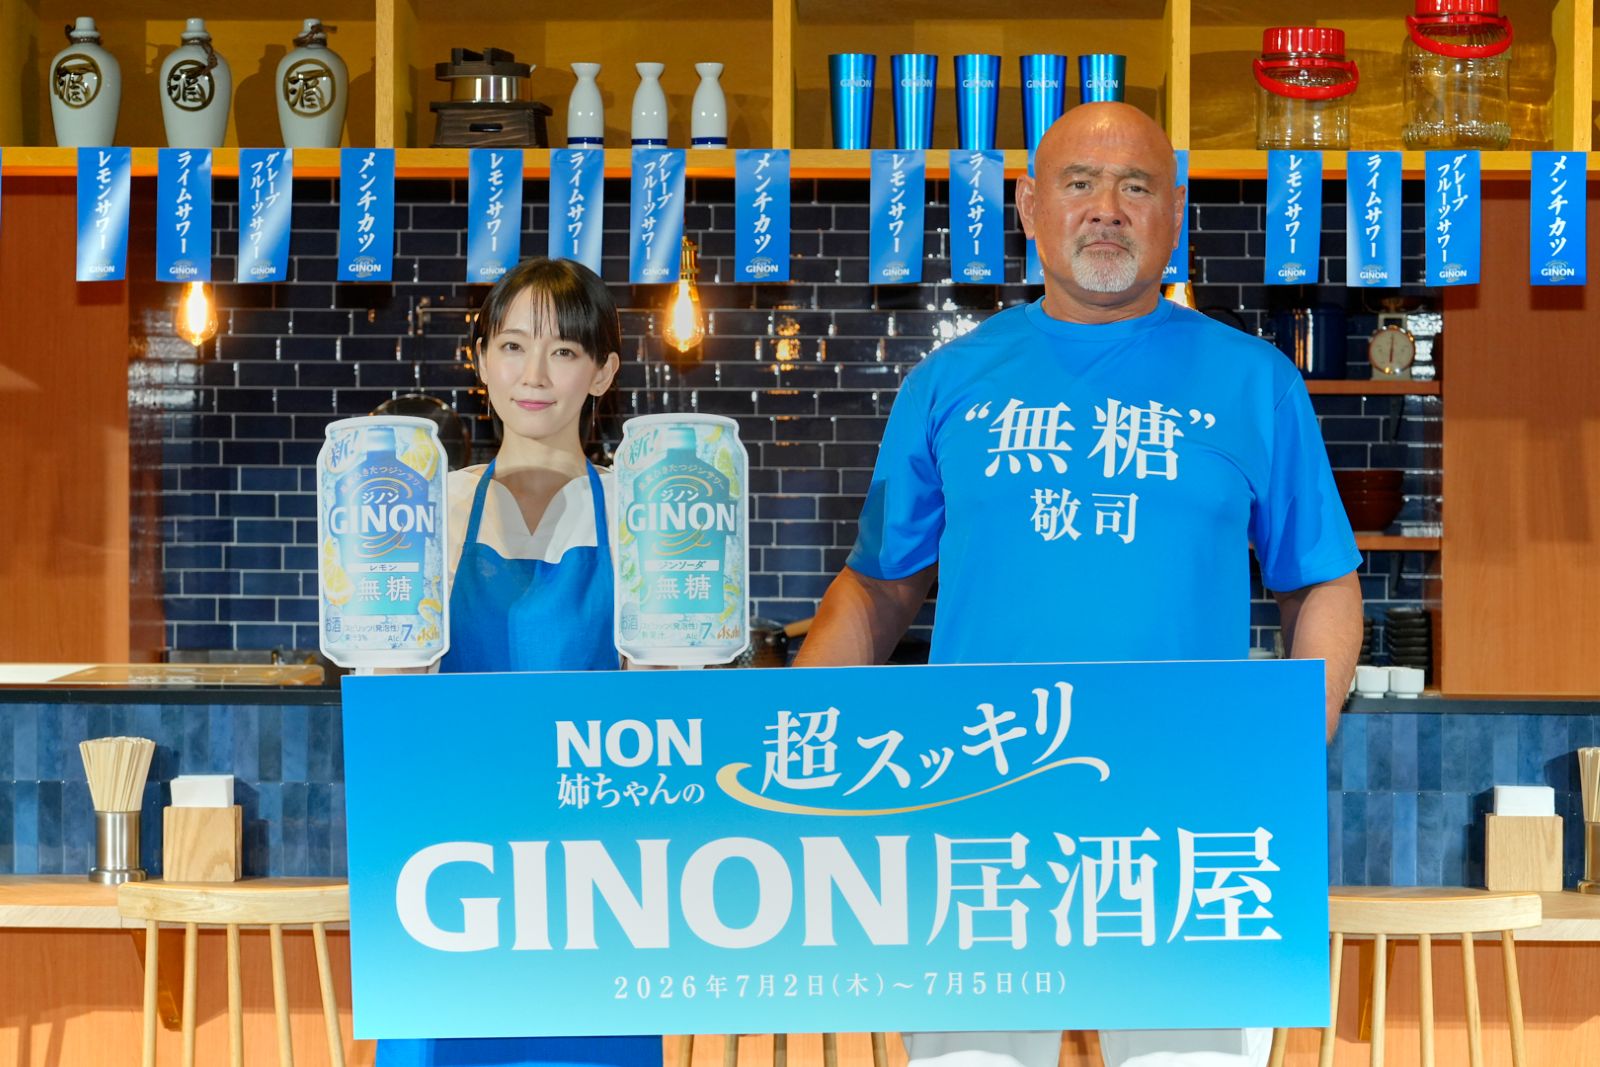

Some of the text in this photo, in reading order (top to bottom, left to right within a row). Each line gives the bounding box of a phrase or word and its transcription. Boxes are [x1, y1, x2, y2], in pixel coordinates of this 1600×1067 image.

[95, 151, 112, 250] レモンサワー
[175, 151, 193, 254] ライムサワー
[265, 151, 281, 209] グレープ
[356, 151, 377, 253] メンチカツ
[486, 153, 504, 252] レモンサワー
[567, 151, 585, 255] ライムサワー
[657, 152, 673, 210] グレープ
[752, 152, 773, 254] メンチカツ
[888, 153, 906, 253] レモンサワー
[967, 152, 985, 256] ライムサワー
[1284, 154, 1303, 255] レモンサワー
[1452, 153, 1468, 212] グレープ
[250, 160, 265, 259] フルーツサワー
[641, 161, 658, 261] フルーツサワー
[1365, 154, 1383, 259] ライムサワー
[1436, 163, 1452, 263] フルーツサワー
[1547, 155, 1568, 257] メンチカツ
[169, 266, 198, 275] GINON
[250, 266, 276, 275] GINON
[348, 263, 382, 273] GINON
[480, 266, 506, 276] GINON
[642, 267, 669, 276] GINON
[745, 264, 779, 273] GINON
[882, 267, 910, 277] GINON
[963, 267, 991, 277] GINON
[1278, 268, 1306, 278] GINON
[1360, 270, 1388, 280] GINON
[1439, 269, 1467, 279] GINON
[1541, 268, 1575, 277] GINON
[964, 397, 1217, 481] “無糖”
[330, 503, 435, 534] GINON
[362, 491, 400, 504] ジノン
[627, 501, 736, 532] GINON
[661, 489, 699, 502] ジノン
[1030, 488, 1139, 544] 敬司
[359, 575, 413, 602] 無糖
[369, 563, 398, 572] レモン
[655, 573, 712, 600] 無糖
[555, 718, 703, 768] NON
[759, 681, 1074, 796] 超スッキリ
[556, 772, 705, 810] 姉ちゃんの
